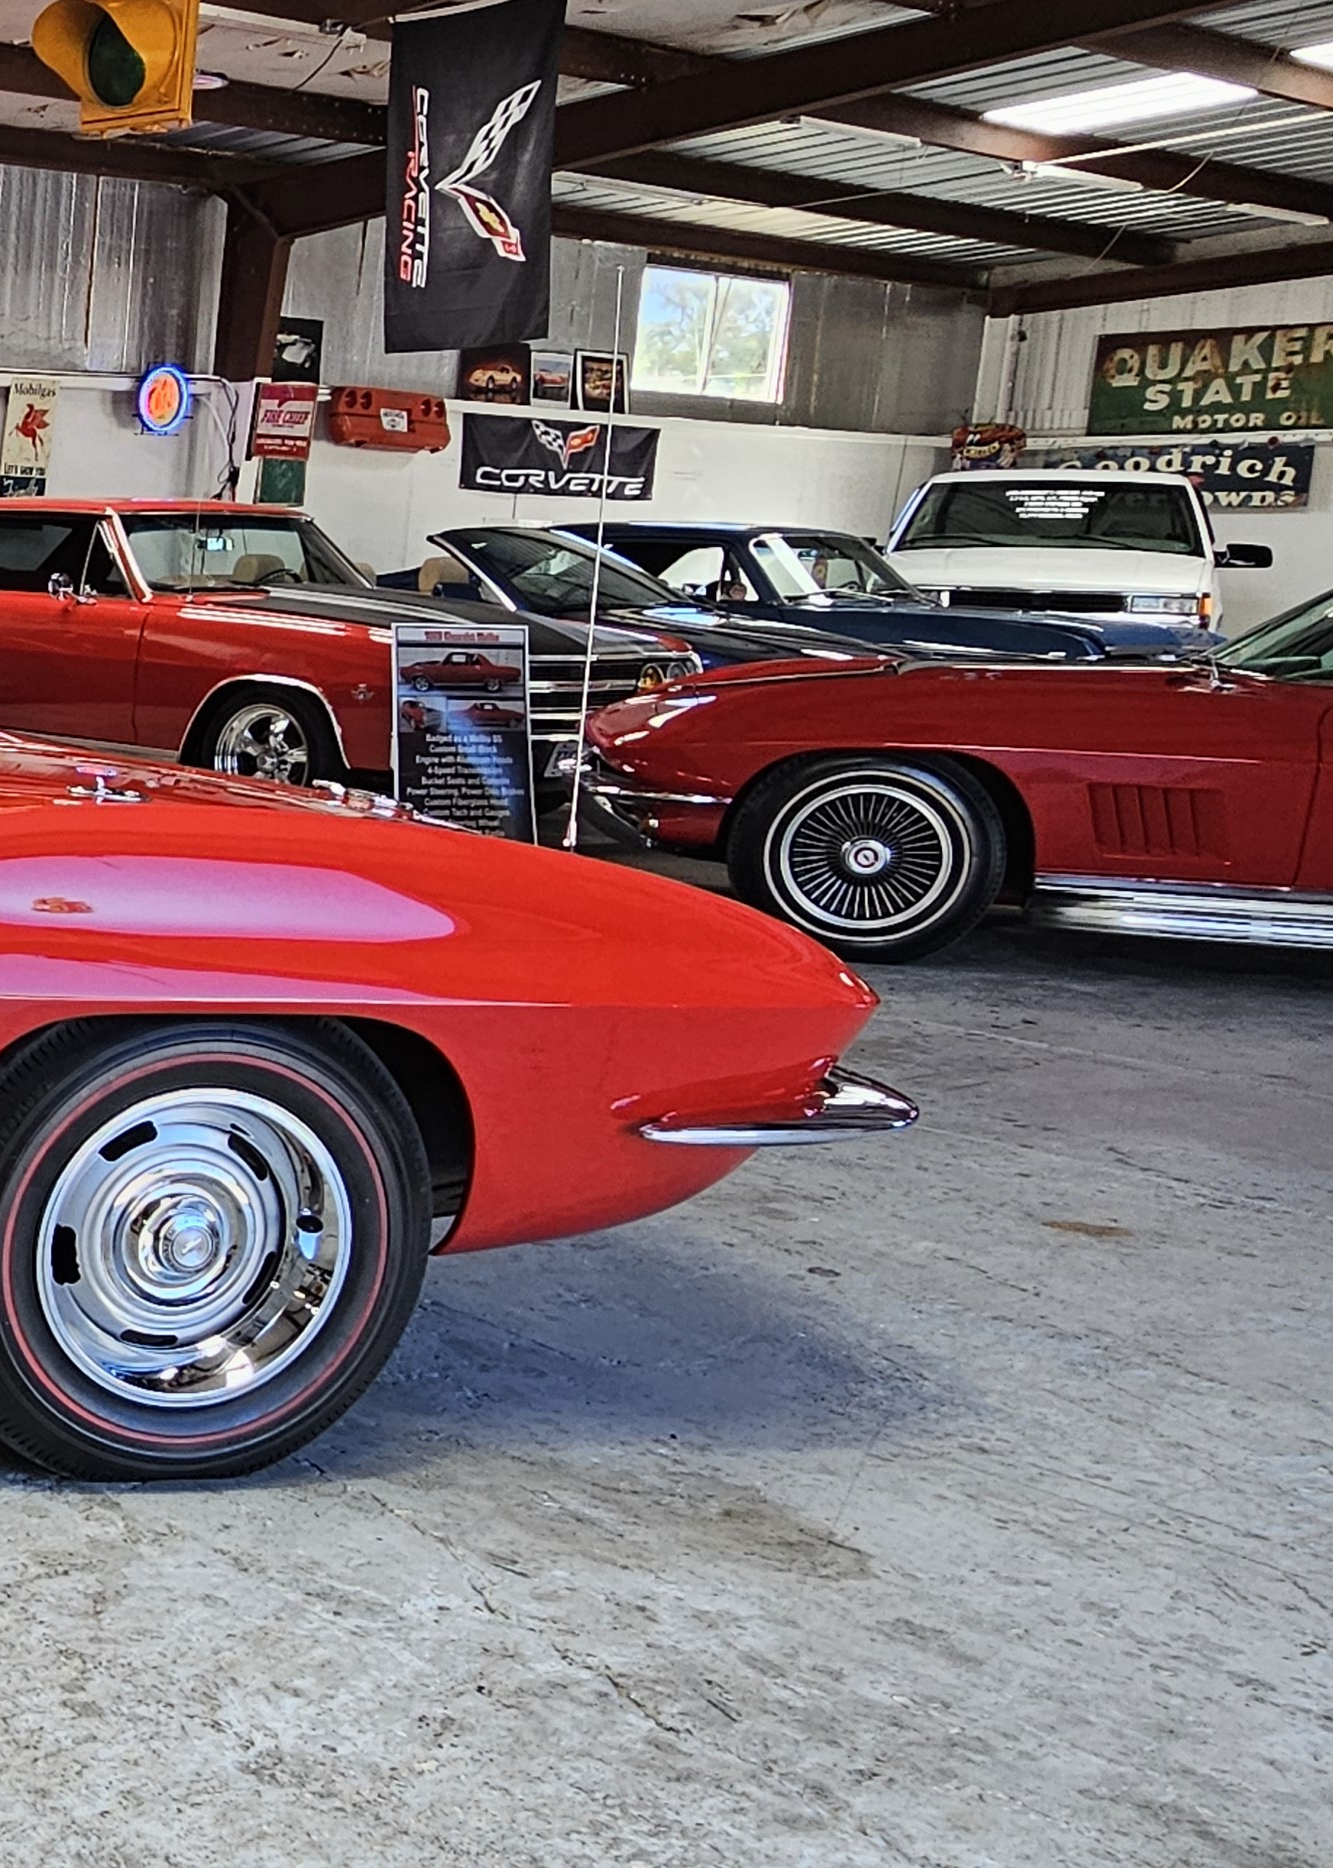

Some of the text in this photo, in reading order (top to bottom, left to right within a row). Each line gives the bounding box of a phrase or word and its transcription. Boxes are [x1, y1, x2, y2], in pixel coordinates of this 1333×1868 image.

[412, 87, 430, 289] CORVETTE
[399, 150, 419, 282] RACING
[15, 383, 57, 399] Mobilgas
[1143, 372, 1293, 411] STATE
[1171, 411, 1324, 430] MOTOR OIL
[476, 466, 645, 496] CORVETTE
